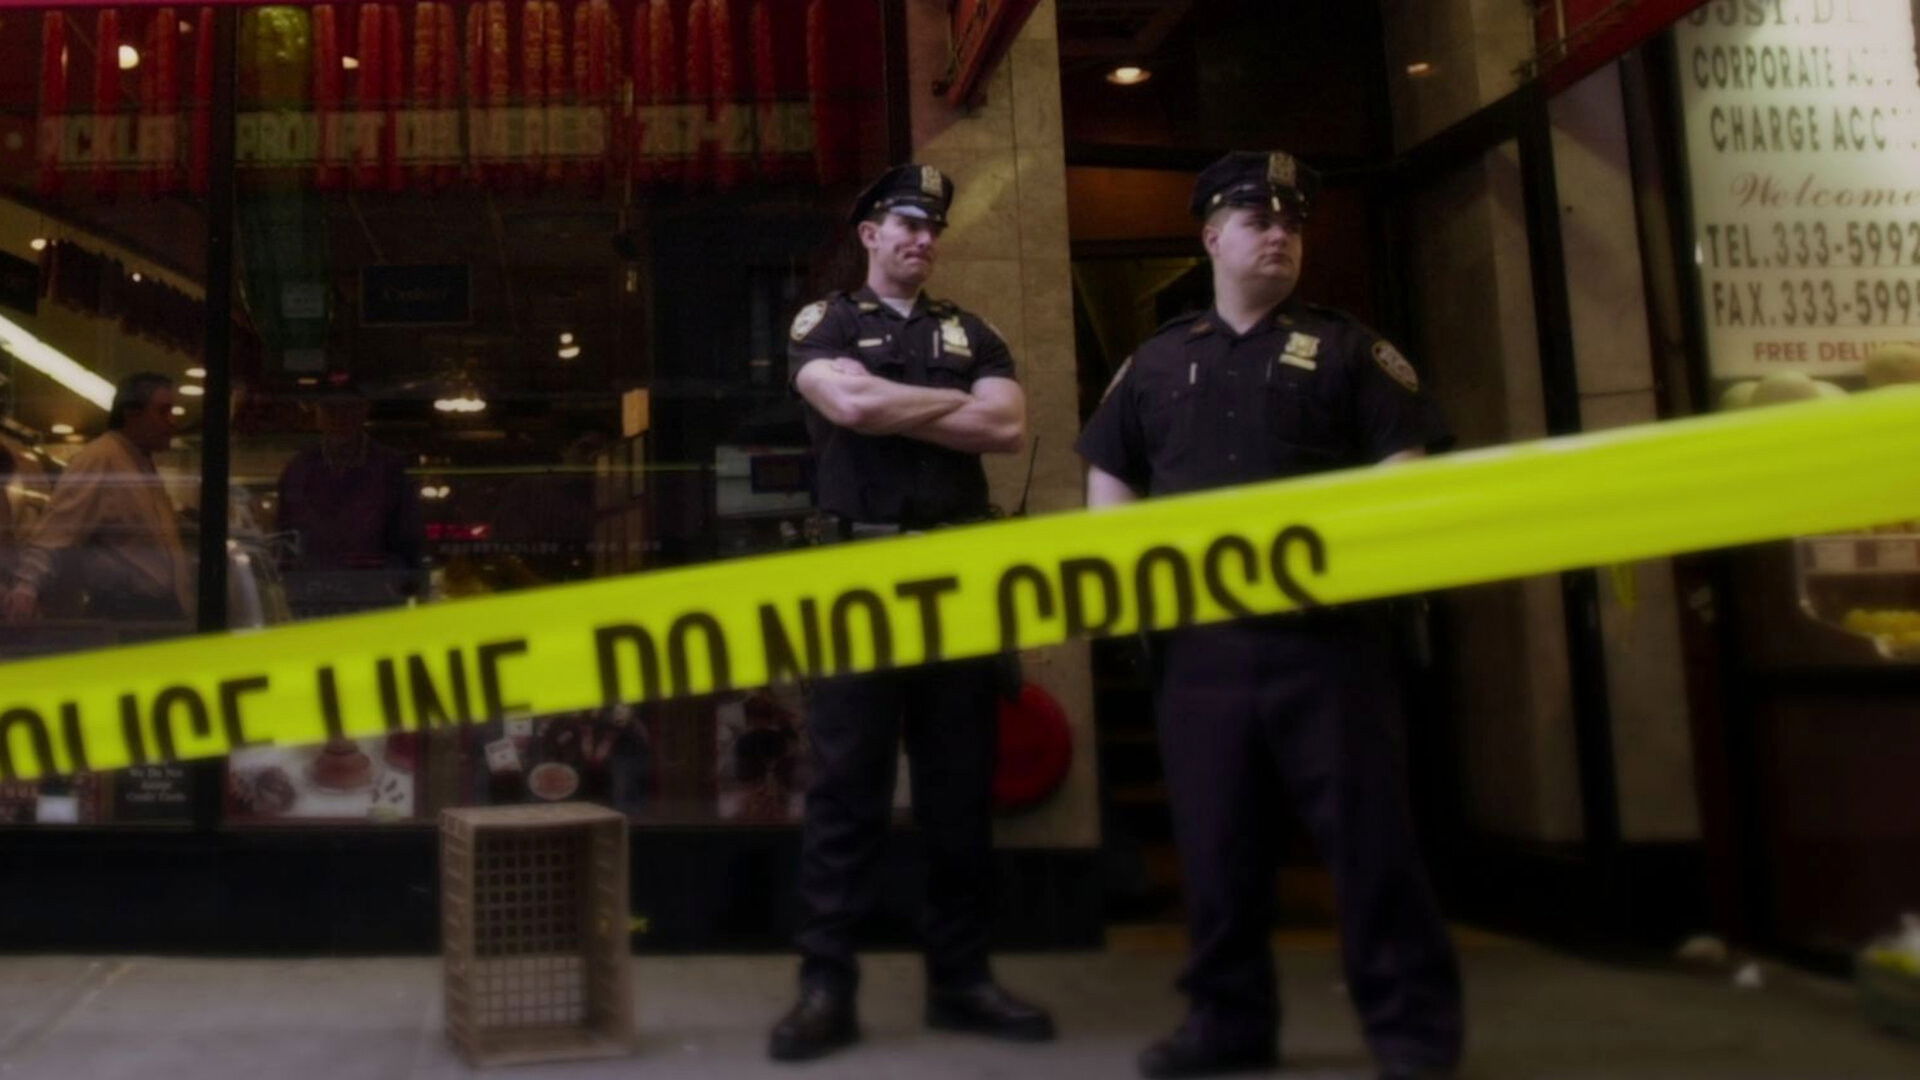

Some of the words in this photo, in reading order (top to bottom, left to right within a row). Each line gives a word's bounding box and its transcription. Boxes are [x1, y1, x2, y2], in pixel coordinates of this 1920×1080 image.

[1693, 45, 1836, 89] CORPORATE
[1709, 104, 1821, 152] CHARGE
[1712, 278, 1920, 327] FAX.333-599
[1754, 341, 1809, 362] FREE
[594, 609, 733, 705] DO
[758, 575, 960, 690] NOT
[997, 523, 1326, 653] CROSS
